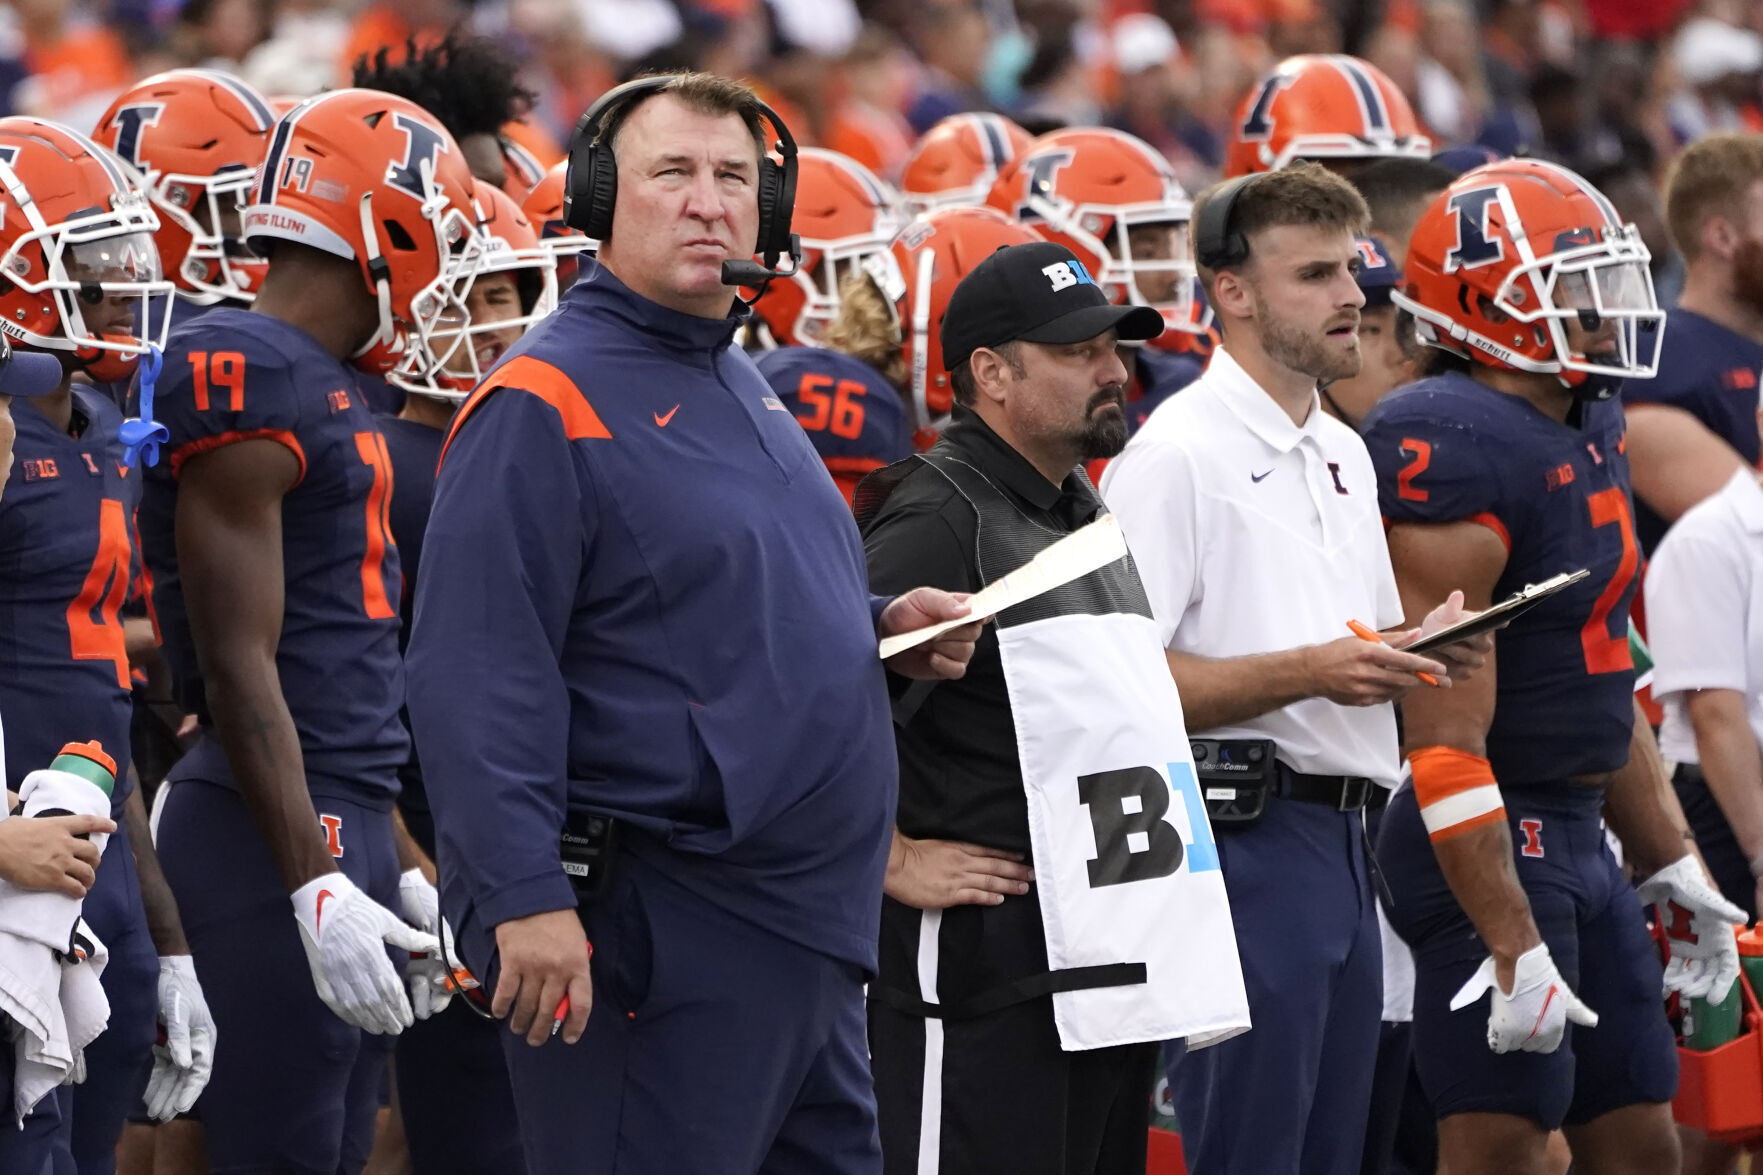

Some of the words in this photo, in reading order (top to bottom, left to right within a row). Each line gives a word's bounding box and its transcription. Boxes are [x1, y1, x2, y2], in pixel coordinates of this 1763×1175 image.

[112, 101, 167, 176] I
[383, 111, 449, 203] I
[281, 156, 313, 193] 19
[1013, 146, 1077, 224] I
[1442, 184, 1506, 275] I
[1355, 239, 1387, 269] I
[0, 320, 26, 340] hutt
[187, 350, 246, 412] 19
[795, 372, 868, 441] 56
[81, 452, 100, 474] I
[1397, 437, 1432, 503] 2
[1587, 443, 1603, 466] I
[1326, 462, 1349, 495] I
[65, 498, 133, 691] 4
[1580, 487, 1639, 674] 2
[1201, 762, 1250, 772] CoachComm
[319, 813, 344, 859] I
[560, 833, 589, 845] Comm
[1519, 819, 1545, 859] I
[1665, 898, 1699, 946] I
